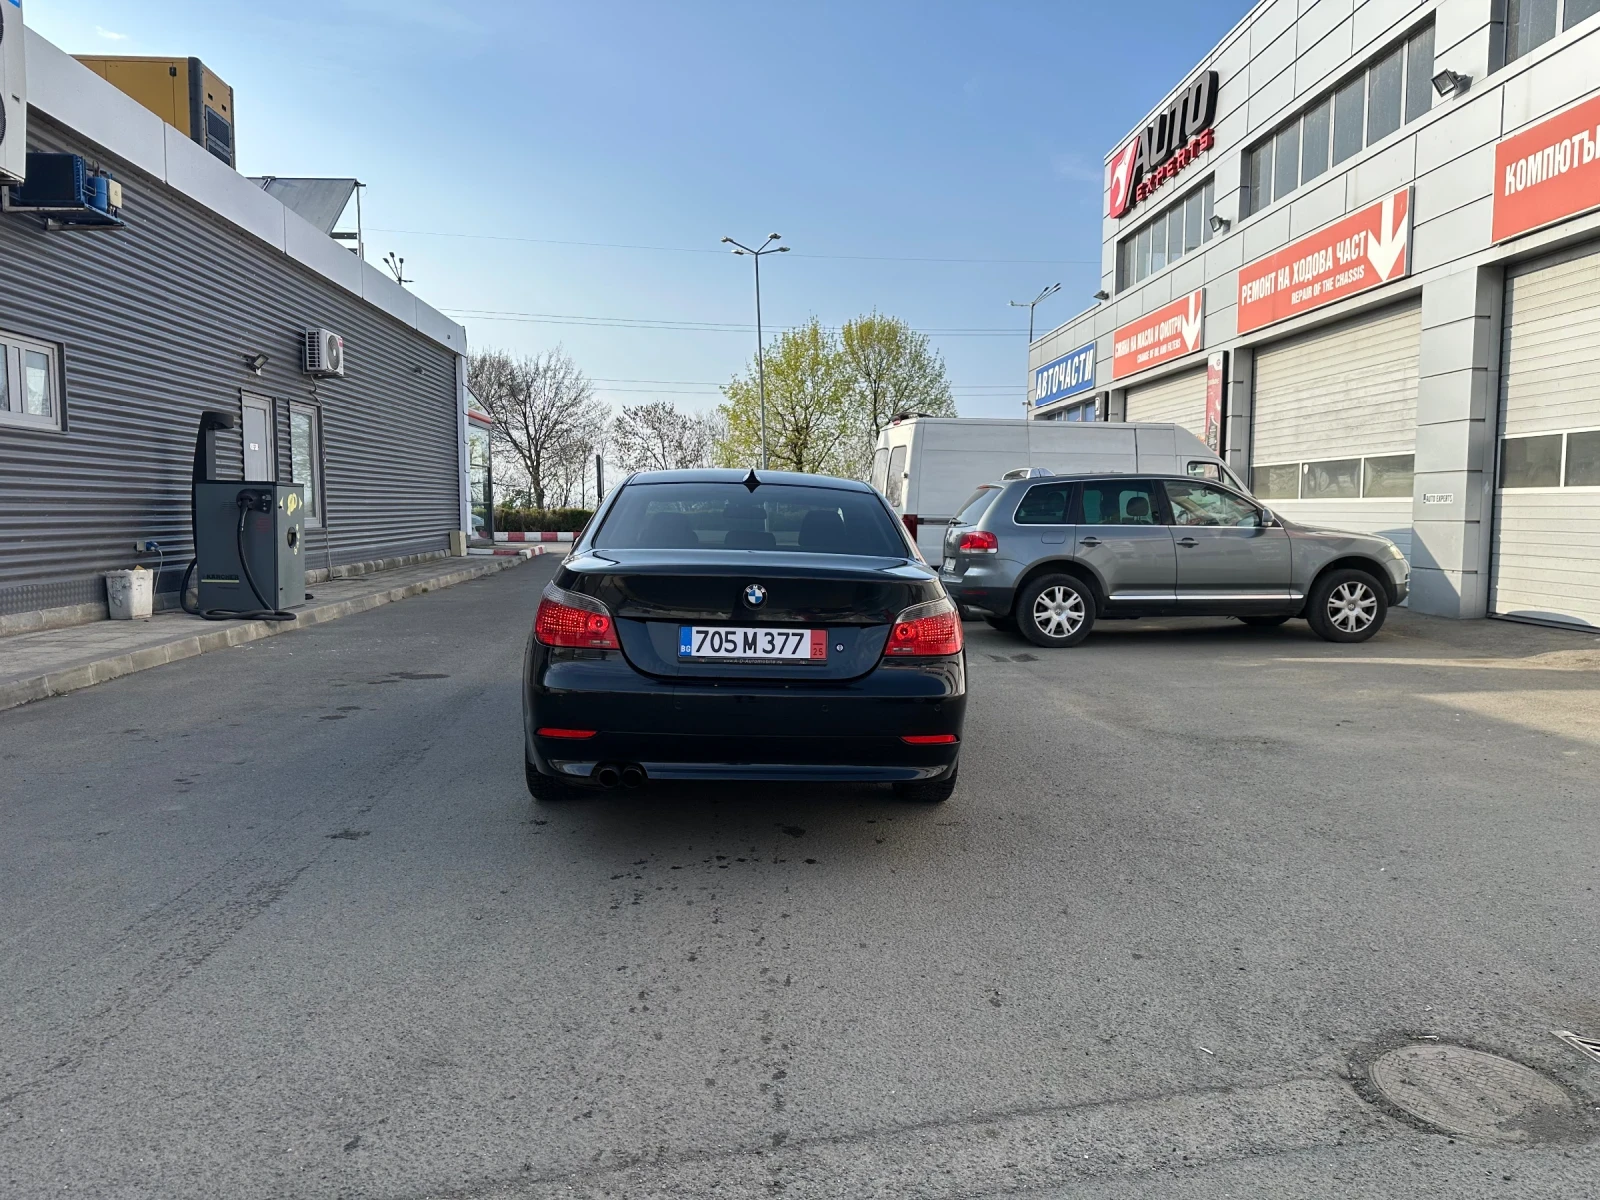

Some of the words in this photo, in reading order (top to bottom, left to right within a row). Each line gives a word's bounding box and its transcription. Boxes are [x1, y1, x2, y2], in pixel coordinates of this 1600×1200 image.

[1126, 70, 1218, 208] AUTO
[1136, 128, 1215, 201] EXPERTS
[1241, 271, 1276, 306] РЕМОНТ
[1277, 265, 1291, 292] НА
[1292, 246, 1334, 286] ХОДОВА
[1336, 230, 1367, 266] ЧАСТ
[1291, 284, 1313, 305] REPAIR
[1313, 280, 1321, 297] OF
[1322, 277, 1334, 293] THE
[1335, 264, 1365, 288] CHASSIS
[1035, 348, 1094, 401] АВТОЧАСТИ
[680, 644, 691, 653] BG
[695, 630, 738, 654] 705
[743, 631, 758, 654] M
[762, 631, 805, 655] 377
[812, 647, 824, 656] 25
